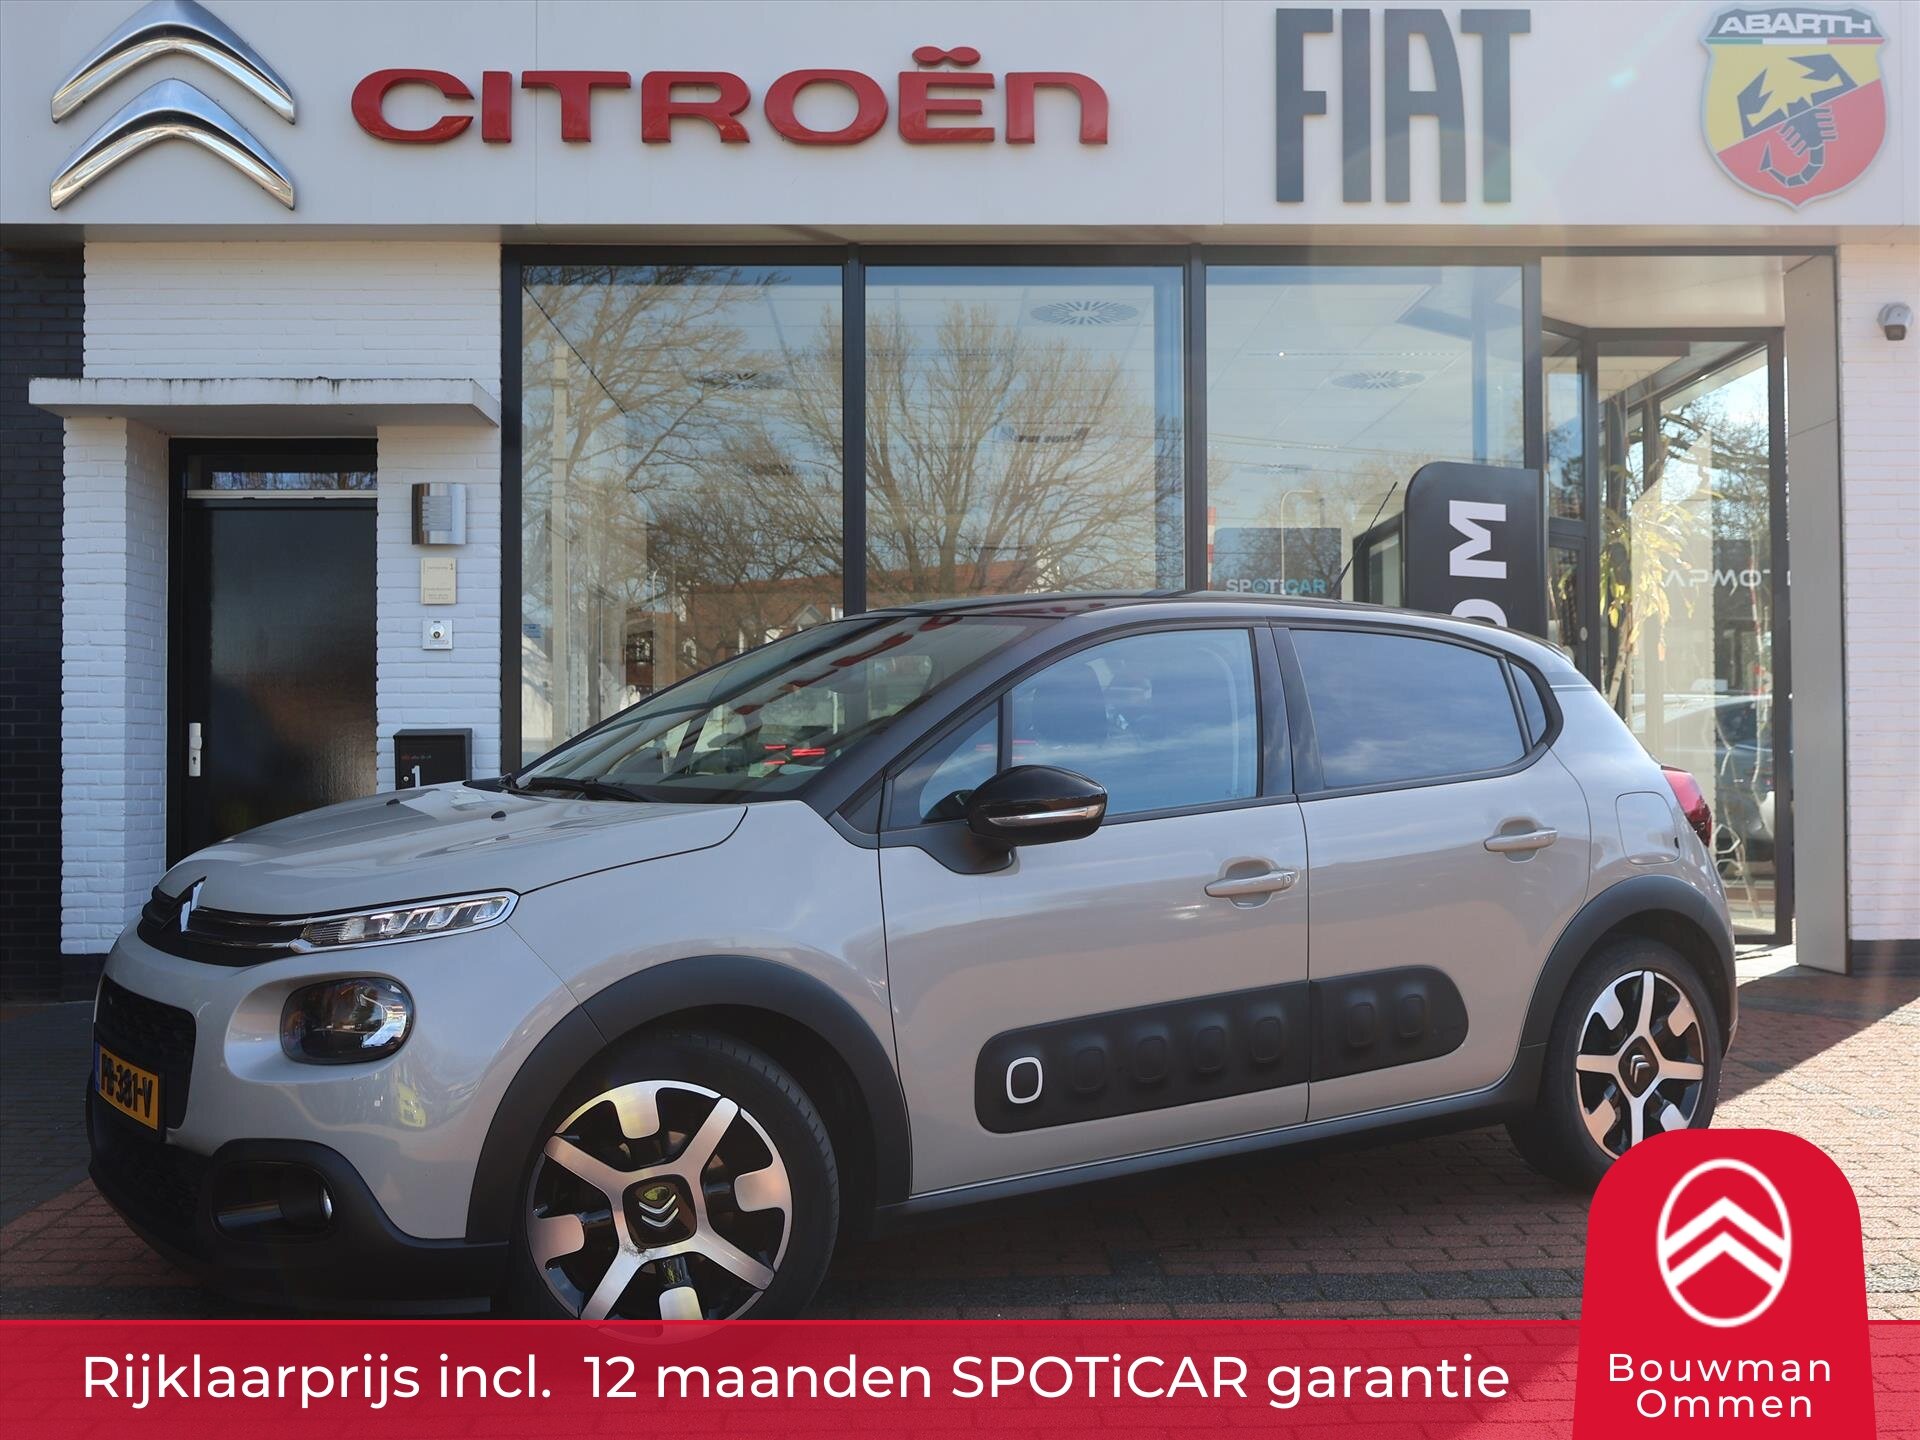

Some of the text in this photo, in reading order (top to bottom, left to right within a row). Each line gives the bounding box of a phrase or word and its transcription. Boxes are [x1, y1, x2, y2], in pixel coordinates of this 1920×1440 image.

[1717, 12, 1872, 35] ABARTH
[351, 45, 1110, 145] CITROËN
[1275, 8, 1532, 203] FIAT
